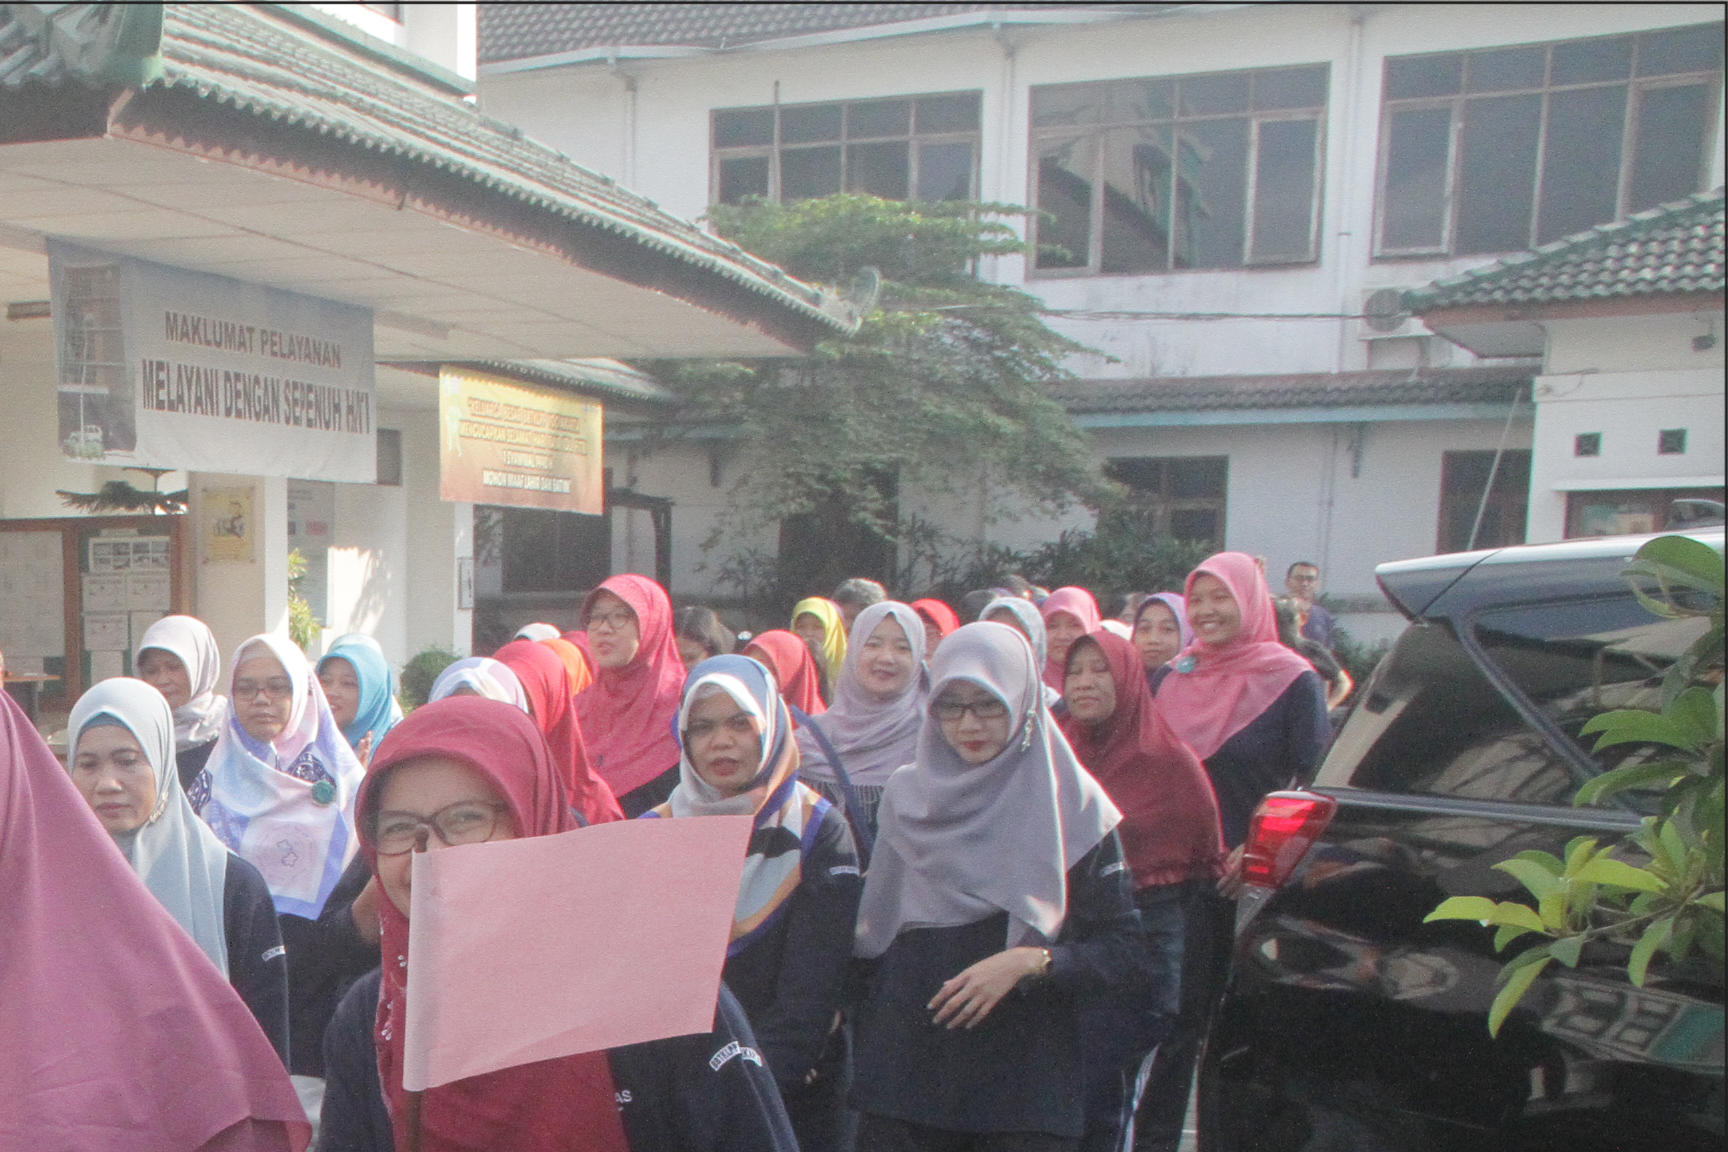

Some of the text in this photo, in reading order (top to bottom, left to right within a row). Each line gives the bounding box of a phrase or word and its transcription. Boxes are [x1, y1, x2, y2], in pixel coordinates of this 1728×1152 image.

[165, 310, 342, 369] MAKLUMAT PELAYANAN
[142, 358, 220, 416] MELAYANI
[223, 370, 281, 424] DENGAN
[284, 379, 342, 431] SEPENUH
